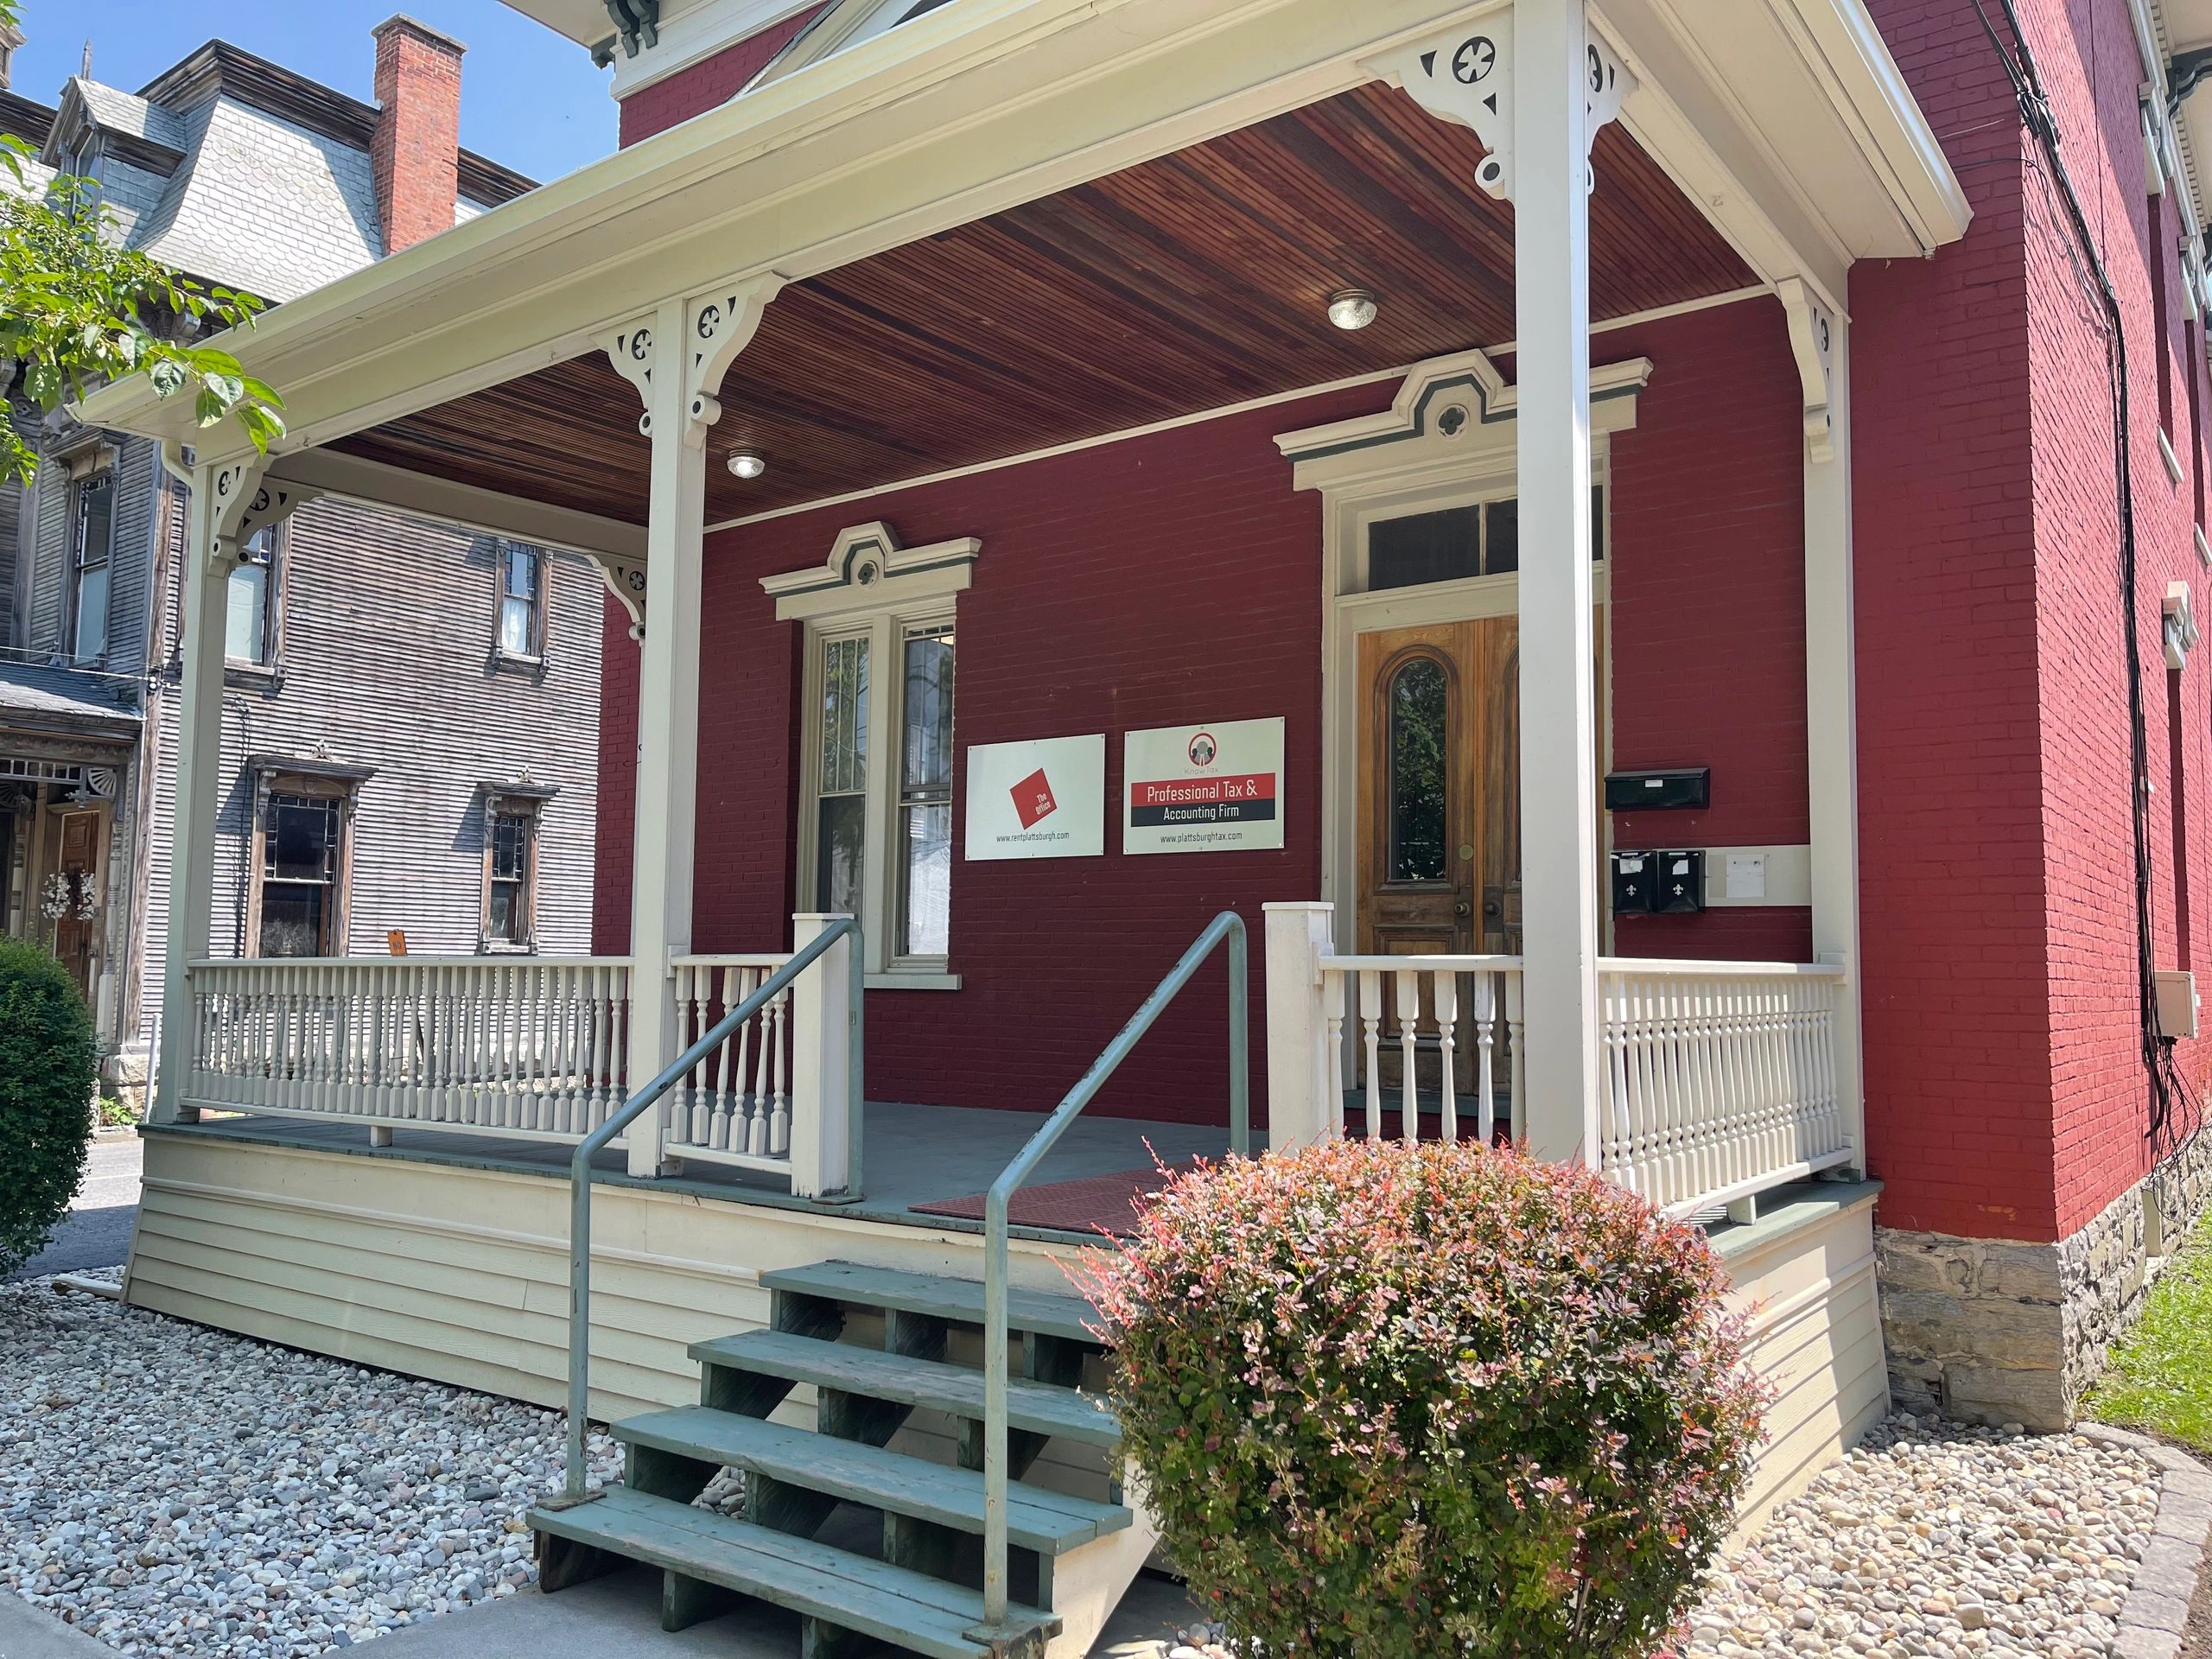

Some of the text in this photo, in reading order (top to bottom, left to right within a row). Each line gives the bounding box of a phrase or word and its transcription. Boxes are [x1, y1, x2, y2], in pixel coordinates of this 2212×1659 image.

[1147, 779, 1257, 802] Professional Tax &
[1037, 793, 1046, 803] The
[1163, 804, 1239, 820] Accounting Firm
[996, 831, 1070, 842] www.rentplattsburgh.com
[1160, 831, 1243, 843] www.plattsburghtax.com
